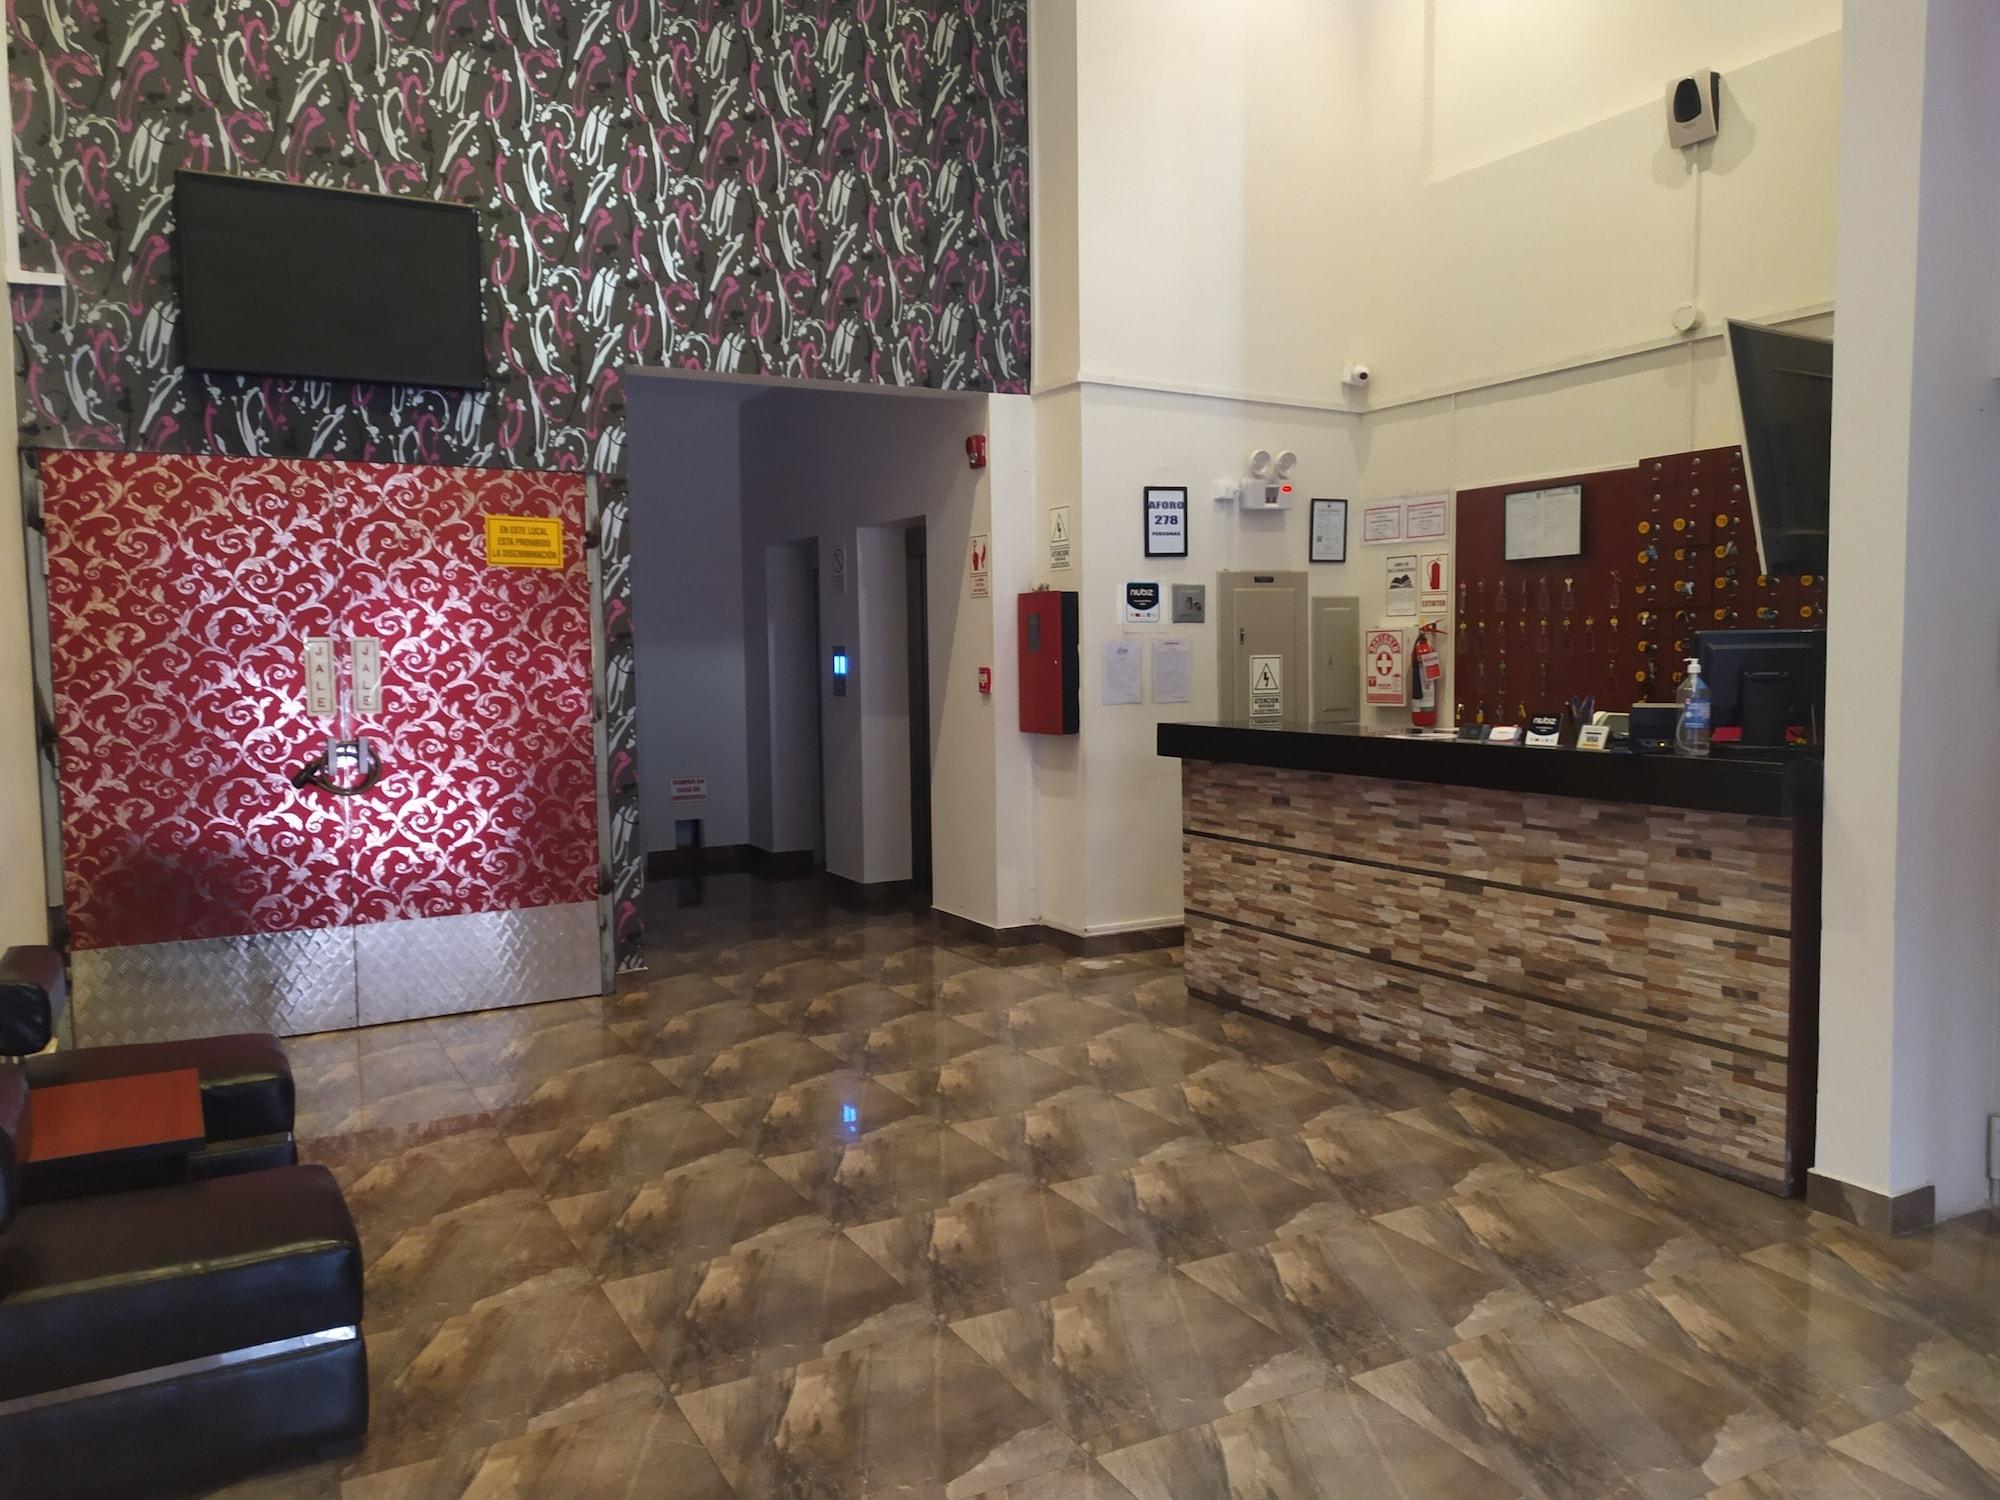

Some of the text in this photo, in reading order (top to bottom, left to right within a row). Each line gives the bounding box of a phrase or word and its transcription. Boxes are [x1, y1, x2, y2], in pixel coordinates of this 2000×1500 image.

[1148, 501, 1184, 509] AFORO
[1154, 515, 1178, 525] 278
[500, 526, 548, 535] EN ESTE LOCAL
[515, 538, 551, 547] PROHIBIDO
[315, 647, 326, 708] JALE
[361, 646, 371, 706] JALE
